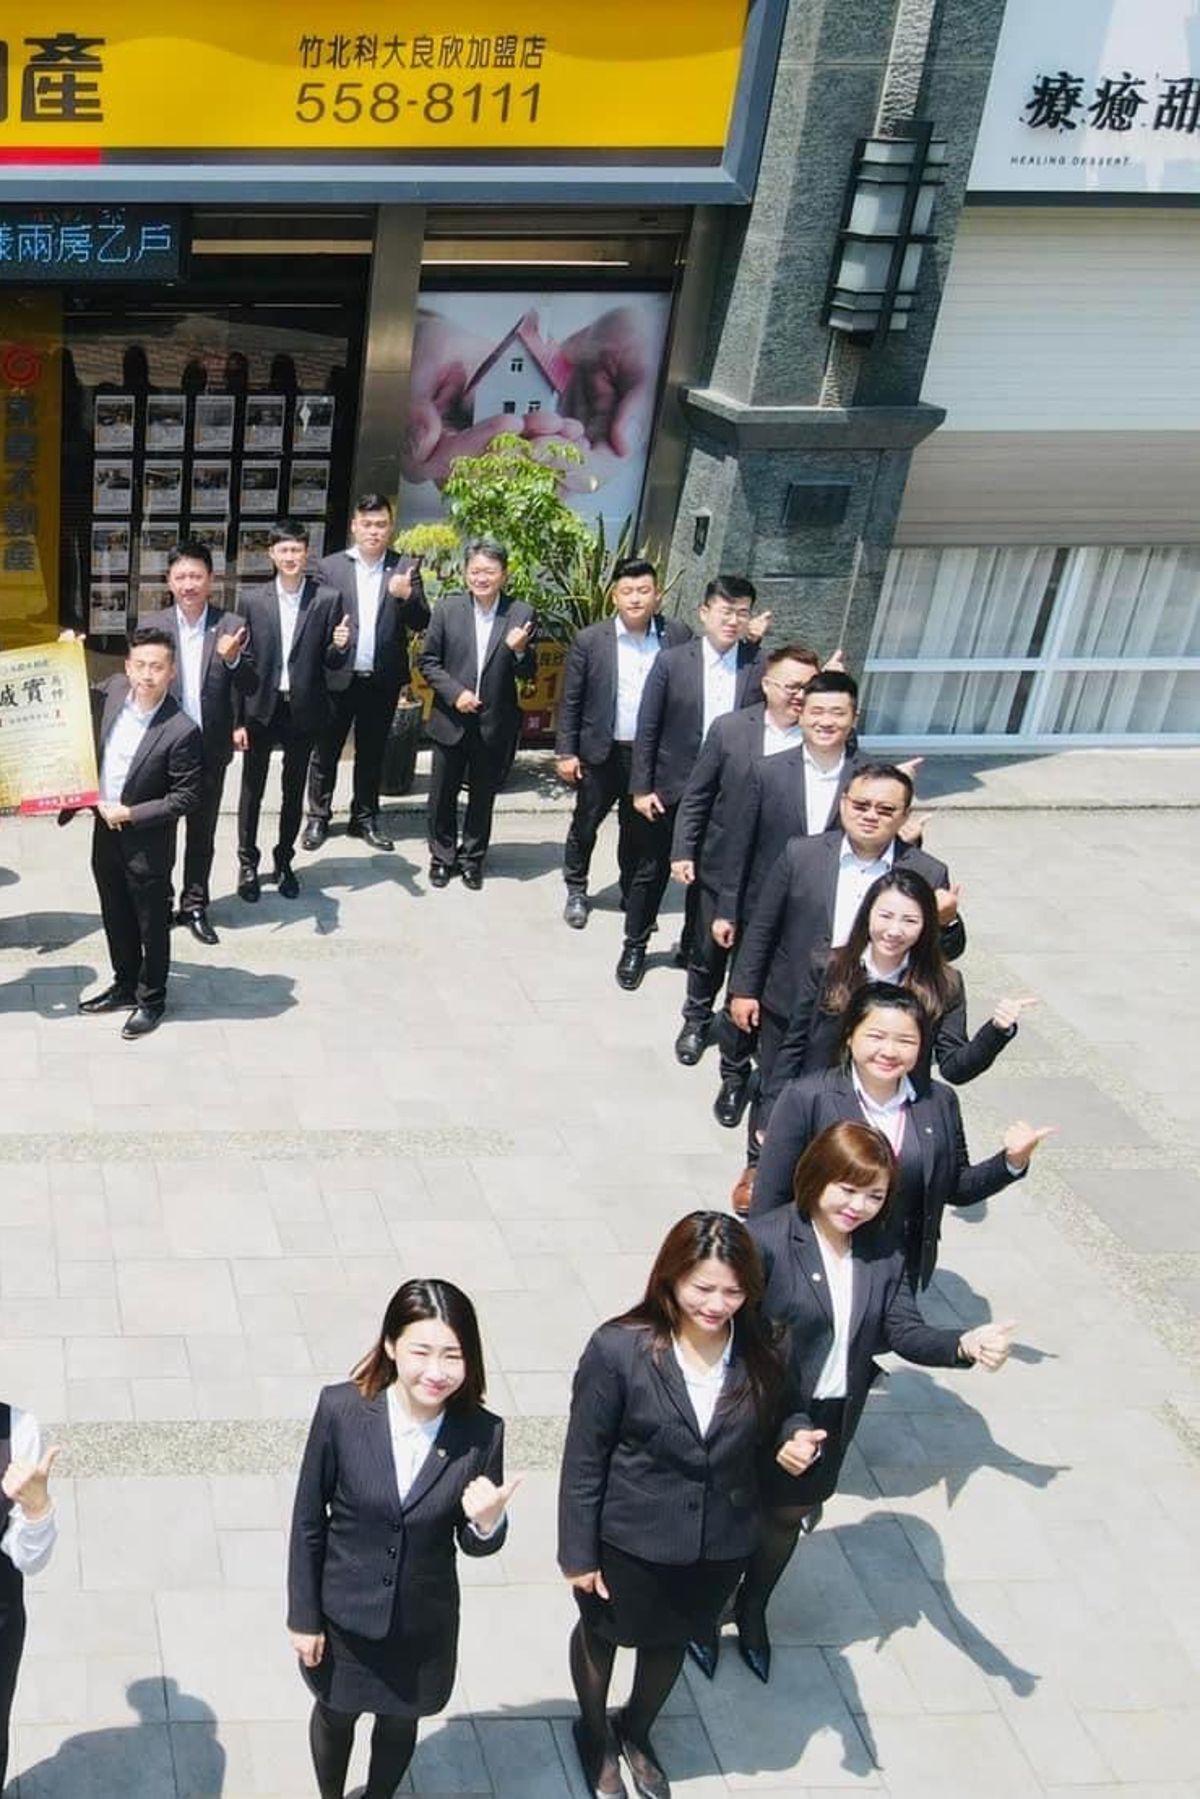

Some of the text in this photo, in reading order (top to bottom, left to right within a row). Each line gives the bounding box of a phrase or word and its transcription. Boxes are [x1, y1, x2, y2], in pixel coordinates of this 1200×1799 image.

[299, 34, 546, 69] 竹北科大良欣加盟店
[295, 82, 540, 123] 558-8111
[1010, 156, 1131, 167] HEALING DESSERT
